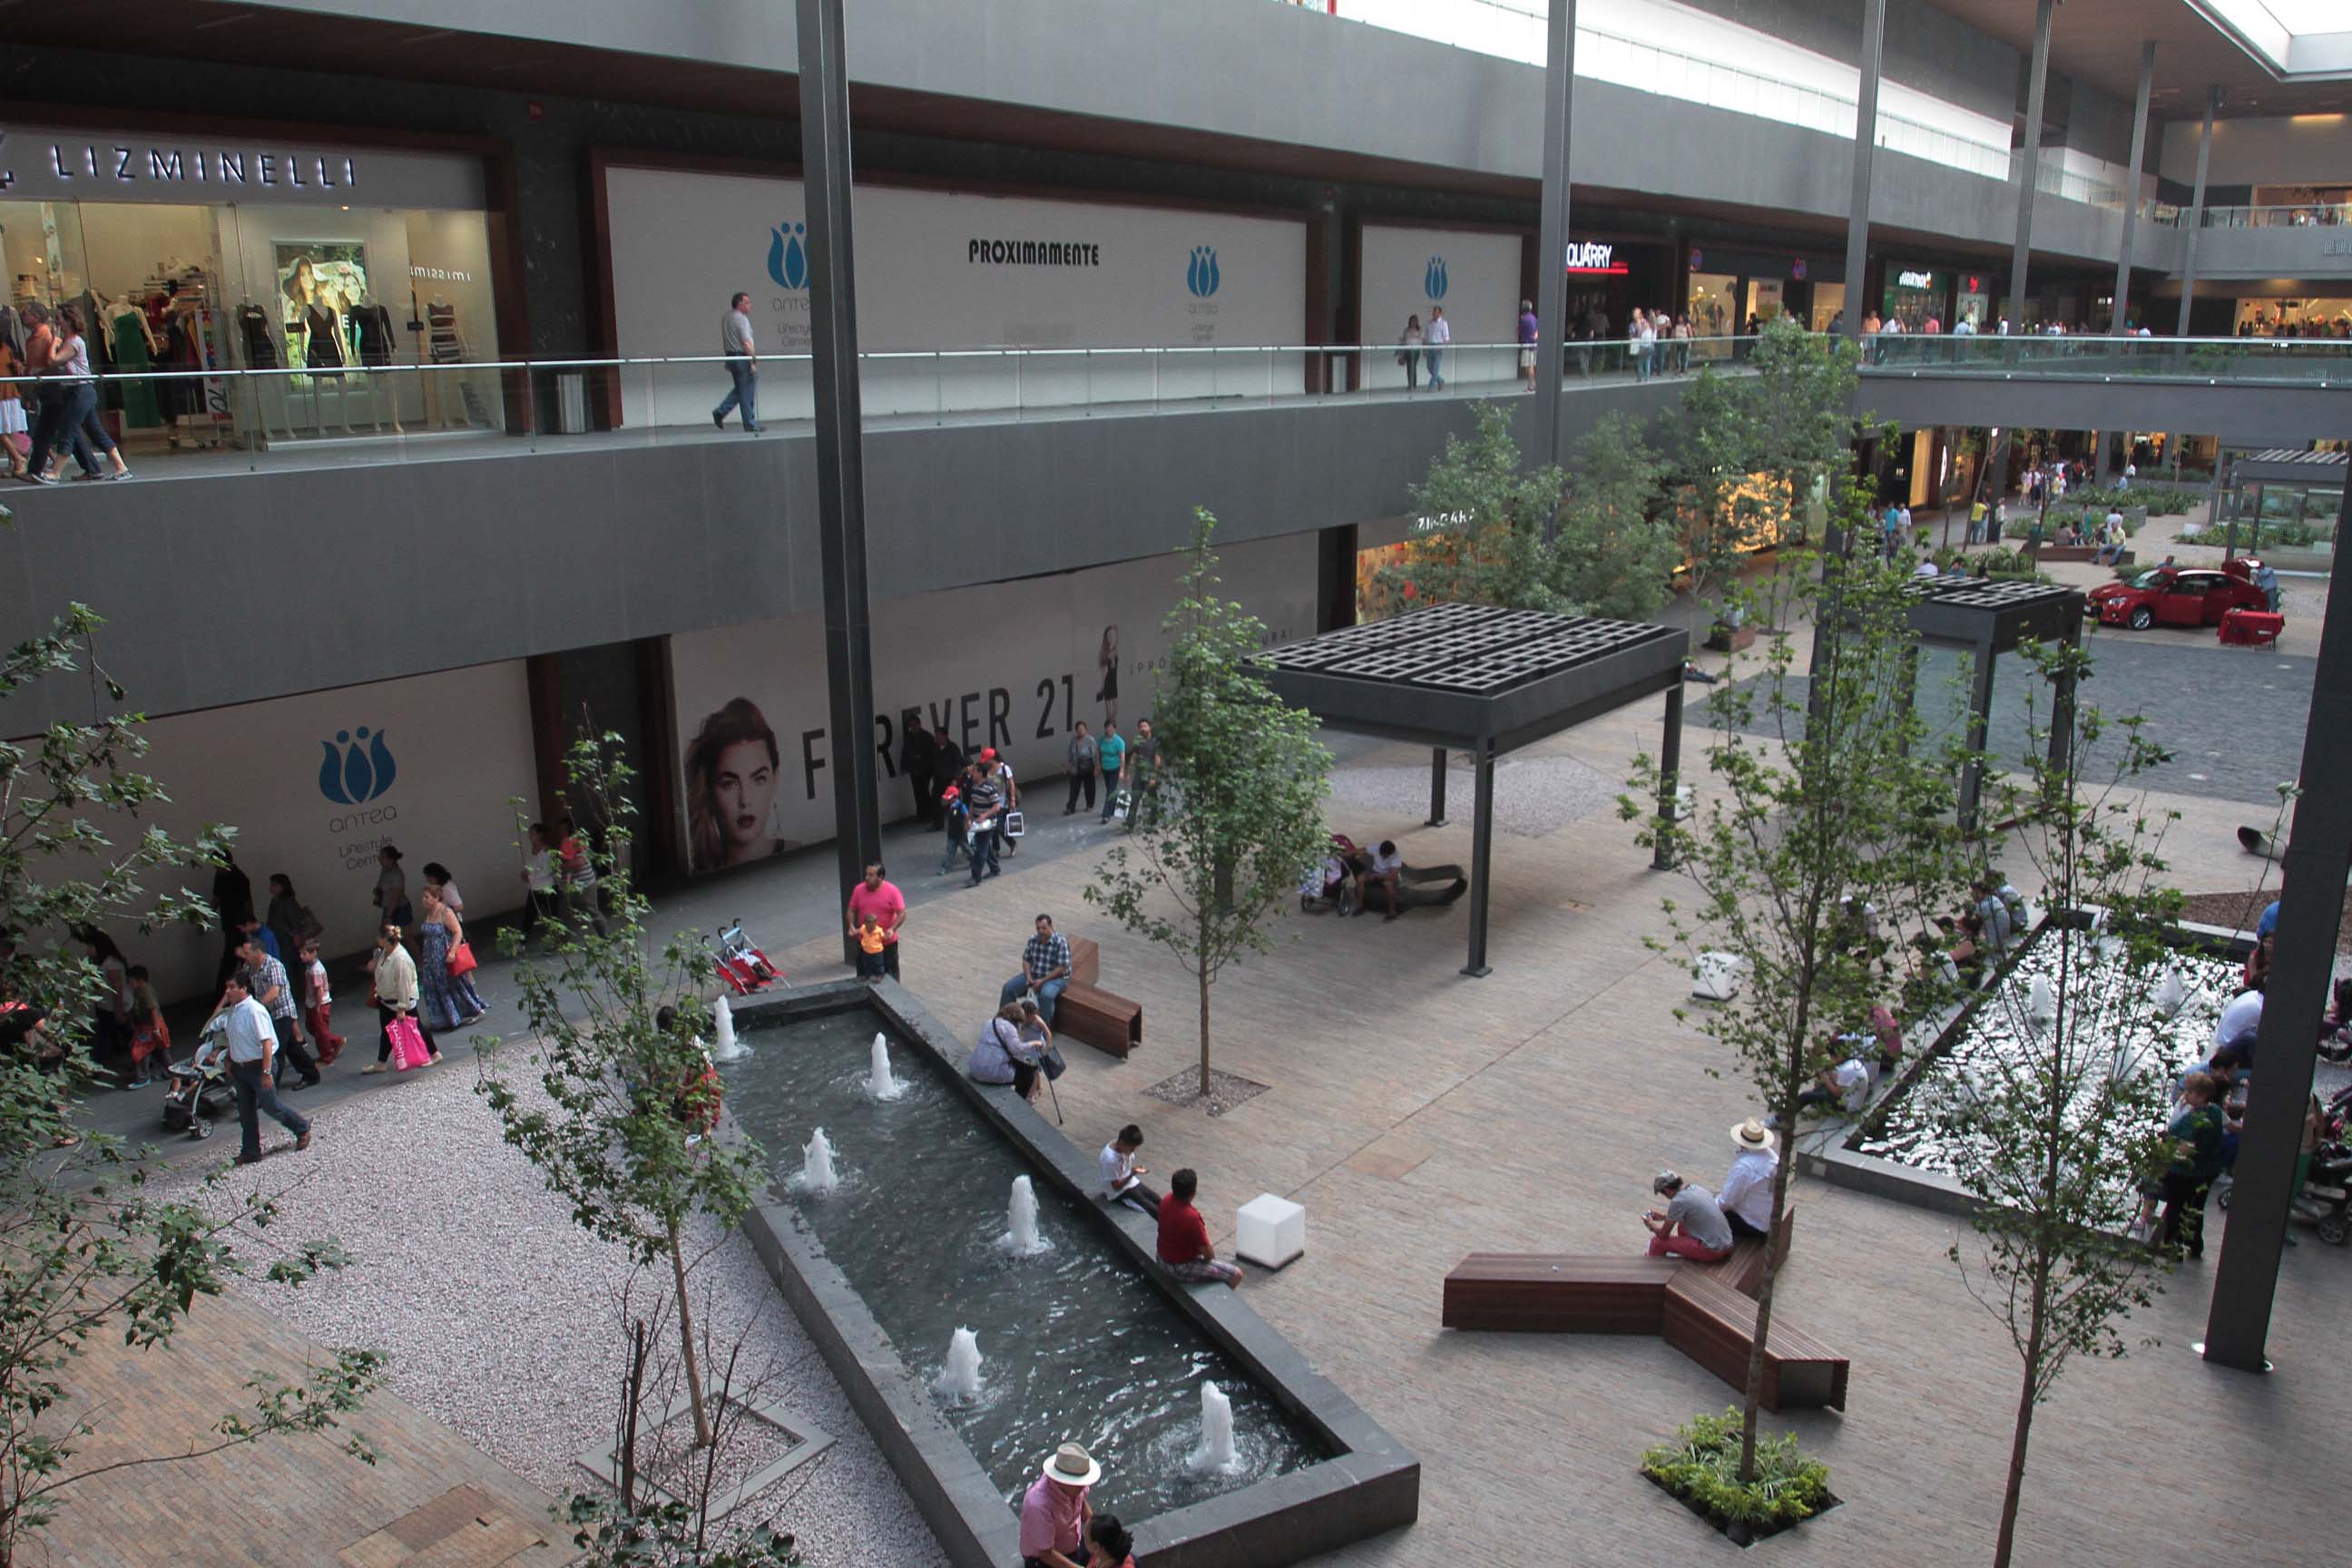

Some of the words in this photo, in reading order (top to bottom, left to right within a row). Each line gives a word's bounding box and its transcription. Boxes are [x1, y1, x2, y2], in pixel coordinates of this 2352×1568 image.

[52, 144, 357, 187] LIZMINELLI
[968, 239, 1099, 266] PROXIMAMENTE
[1567, 240, 1612, 269] QUARRY
[771, 297, 810, 312] ante
[802, 687, 1012, 799] FRVER
[1036, 674, 1073, 740] 21
[329, 805, 397, 833] antea
[347, 854, 378, 870] Cent
